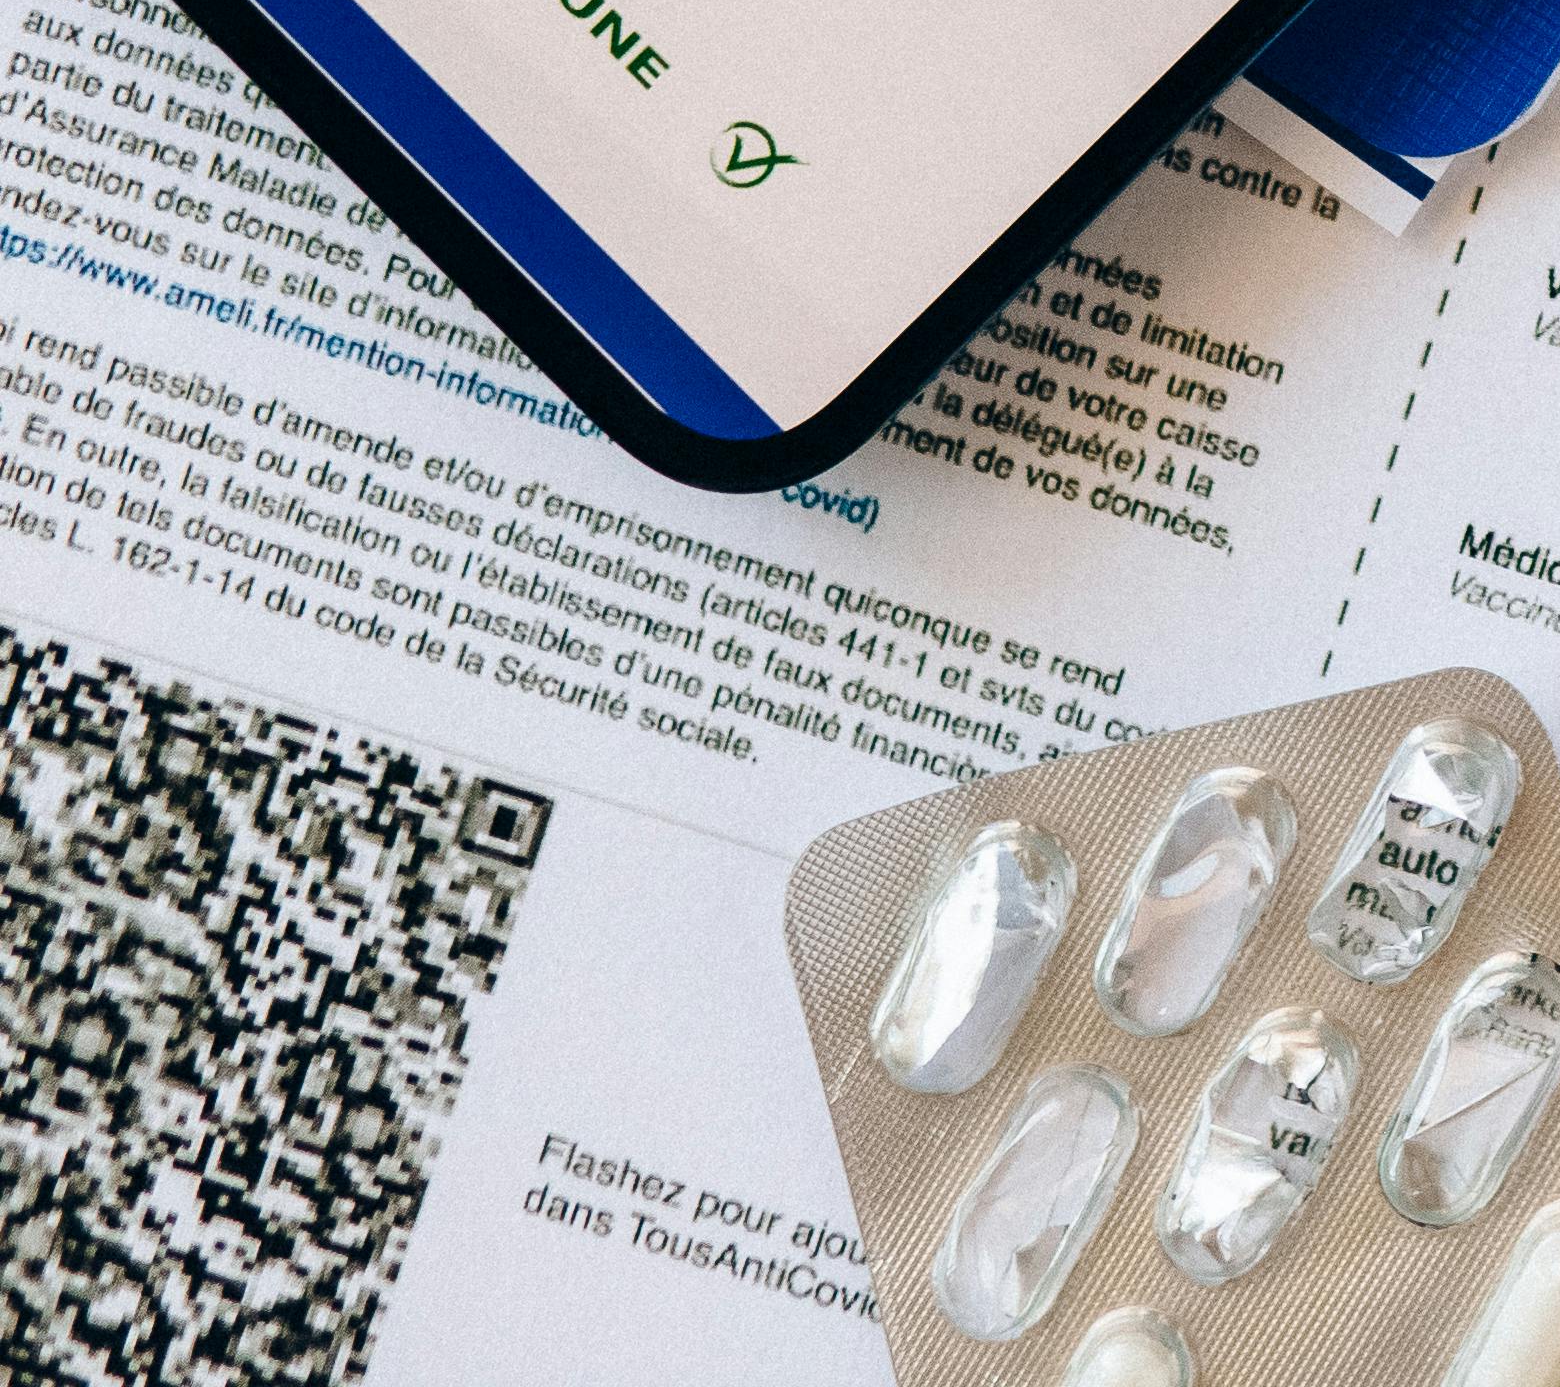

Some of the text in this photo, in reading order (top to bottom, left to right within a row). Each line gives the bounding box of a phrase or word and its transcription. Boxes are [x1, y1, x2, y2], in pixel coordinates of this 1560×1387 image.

[7, 51, 103, 97] partie
[21, 10, 235, 94] aux données
[207, 151, 337, 216] Maladie
[1199, 156, 1302, 208] contre
[153, 185, 212, 224] des
[221, 206, 368, 275] données.
[180, 242, 231, 271] sur
[280, 273, 337, 307] site
[1103, 353, 1159, 388] sur
[1165, 373, 1227, 411] une
[1139, 312, 1284, 384] limitation
[970, 398, 1147, 482] délégué(e)
[1067, 385, 1260, 467] votre caisse
[35, 332, 102, 370] rend
[105, 356, 244, 416] passible
[252, 399, 414, 470] d'amende
[423, 456, 505, 498] et/ou
[514, 482, 815, 599] d'emprisonnement
[823, 583, 991, 654] quiconque
[1049, 655, 1126, 696] rend
[124, 400, 245, 462] fraudes
[357, 473, 483, 537] fausses
[491, 520, 689, 603] déclarations
[699, 582, 826, 646] (articles
[837, 627, 928, 678] 441-1
[1024, 463, 1233, 554] vos données,
[76, 438, 1020, 755] outre, falsification l'établissement faux documents,
[116, 490, 841, 742] tels documents sont passibles d'une pénalité
[114, 536, 757, 763] 162-1-14 code Sécurité sociale.
[522, 1183, 613, 1235] dans
[538, 1133, 686, 1204] Flashez
[692, 1190, 782, 1235] pour
